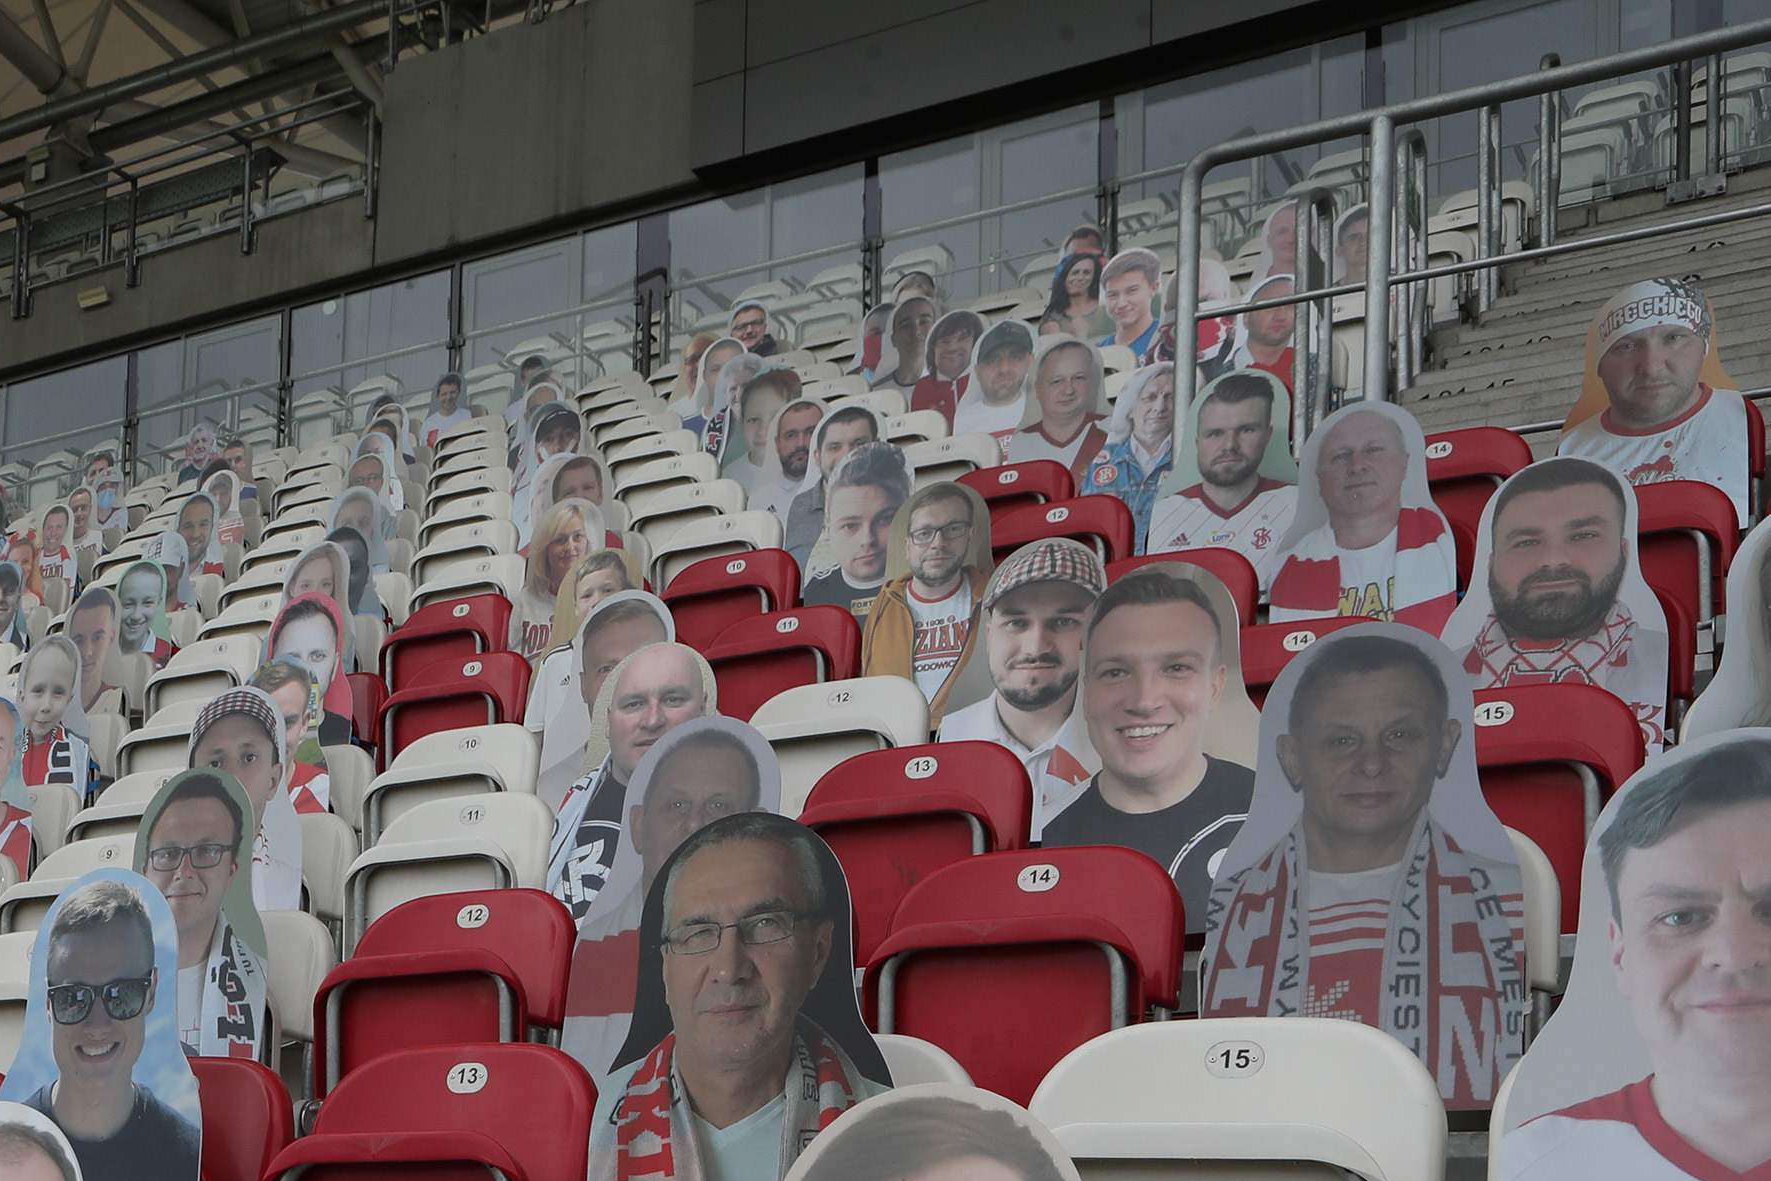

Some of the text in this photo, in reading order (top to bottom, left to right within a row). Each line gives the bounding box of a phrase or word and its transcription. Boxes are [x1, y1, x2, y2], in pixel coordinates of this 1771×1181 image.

[1433, 444, 1447, 454] 14
[1052, 510, 1064, 520] 12
[1292, 634, 1308, 645] 14
[835, 692, 850, 703] 12
[1482, 707, 1505, 720] 15
[464, 739, 477, 749] 10
[913, 759, 930, 773] 13
[466, 810, 479, 821] 11
[106, 850, 113, 860] 9
[1028, 869, 1051, 885] 14
[466, 909, 483, 923] 12
[1220, 1049, 1250, 1069] 15
[457, 1068, 477, 1085] 13
